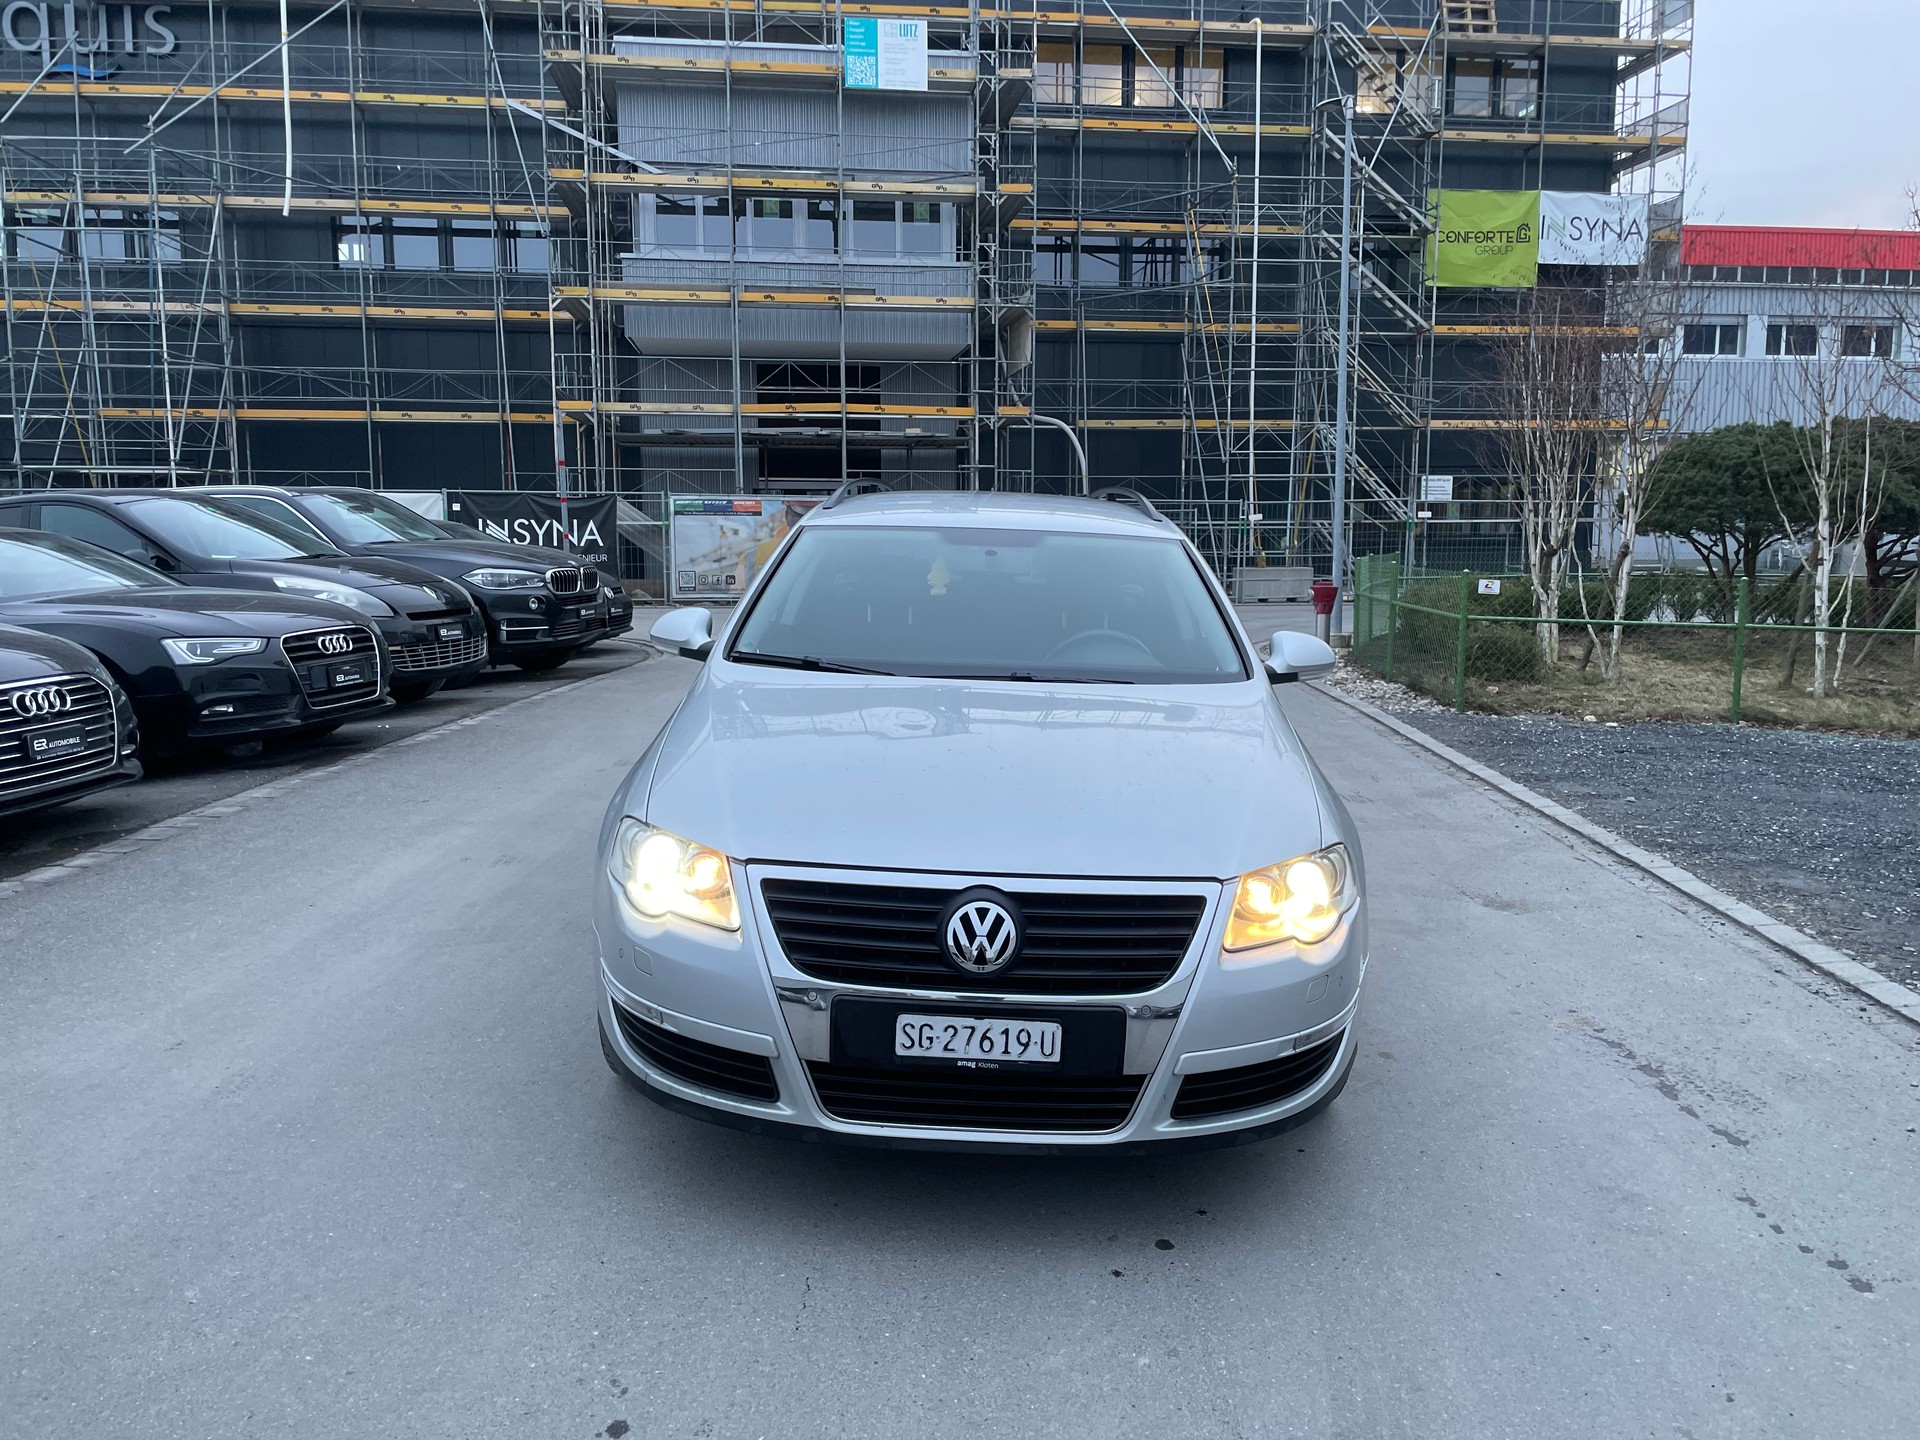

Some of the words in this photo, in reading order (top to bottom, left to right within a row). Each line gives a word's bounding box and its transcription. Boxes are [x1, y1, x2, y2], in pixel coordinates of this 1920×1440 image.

[899, 23, 918, 38] LUTZ
[1540, 214, 1644, 242] INSYNA
[1438, 230, 1515, 244] CONFORTE
[1474, 245, 1514, 256] GROUP
[49, 736, 81, 748] AUTOMOBILE
[957, 1060, 976, 1069] amag
[977, 1060, 999, 1070] Kloten
